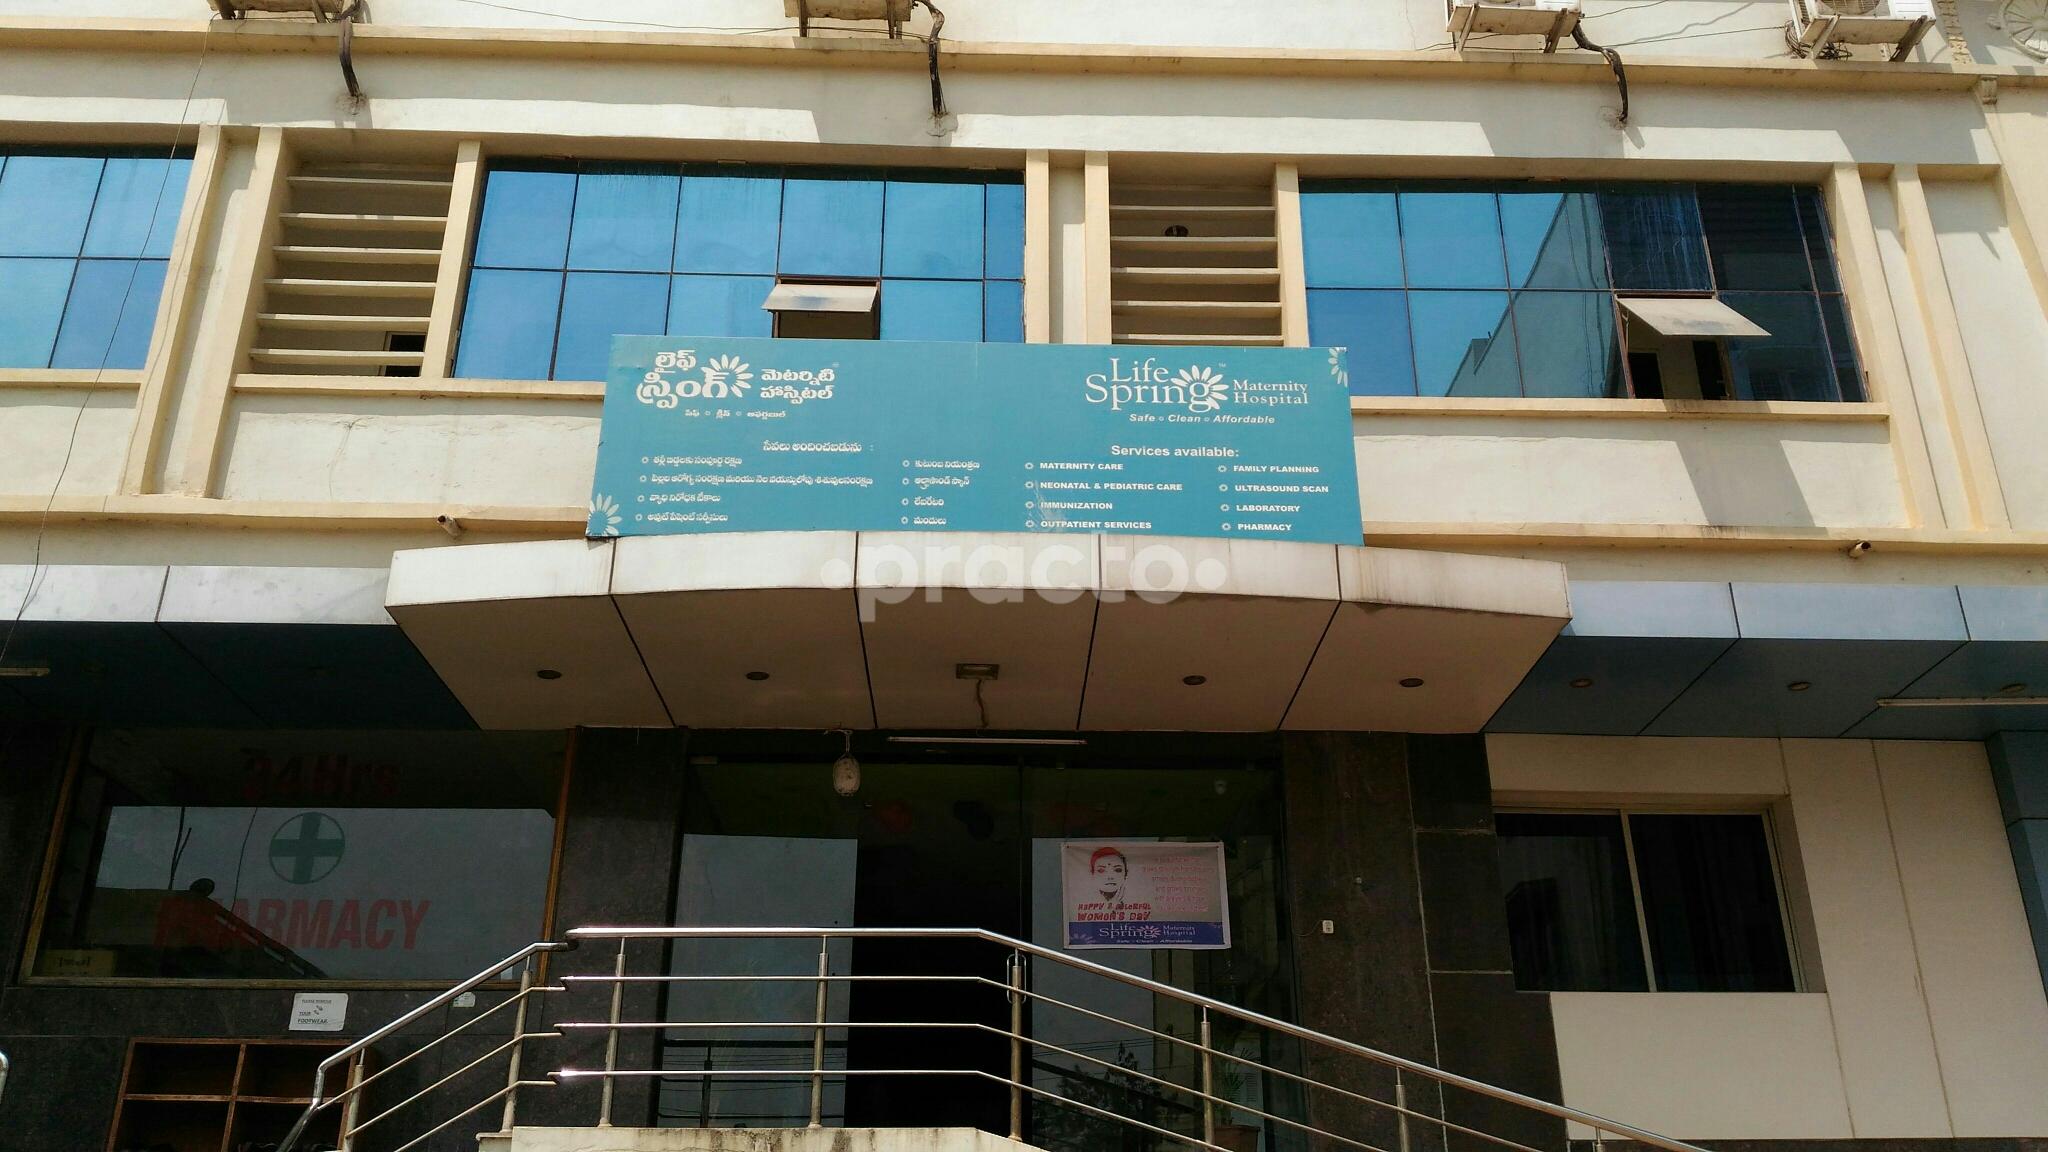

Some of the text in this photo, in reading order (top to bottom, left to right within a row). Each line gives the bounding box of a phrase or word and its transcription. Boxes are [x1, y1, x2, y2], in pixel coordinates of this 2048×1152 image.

[655, 350, 697, 373] లైఫ్
[1110, 358, 1169, 383] Life
[1233, 379, 1308, 393] Maternity
[1085, 374, 1212, 413] Spring
[1233, 392, 1309, 406] Hospital
[1129, 414, 1275, 424] Safe Clean Affordable
[1111, 445, 1239, 457] Services available:
[1040, 462, 1124, 471] MATERNITY CARE
[1233, 465, 1267, 473] FAMILY
[1040, 481, 1183, 491] NEONATAL & PEDIATRIC CARE
[1234, 484, 1329, 494] ULTRASOUND SCAN
[1040, 502, 1113, 510] IMMUNIZATION
[1236, 504, 1300, 512] LABORATORY
[1040, 520, 1152, 530] OUTPATIENT SERVICES
[1237, 523, 1292, 531] PHARMACY
[153, 899, 432, 950] PHARMACY
[1111, 923, 1137, 932] Life
[1099, 928, 1157, 939] Spring
